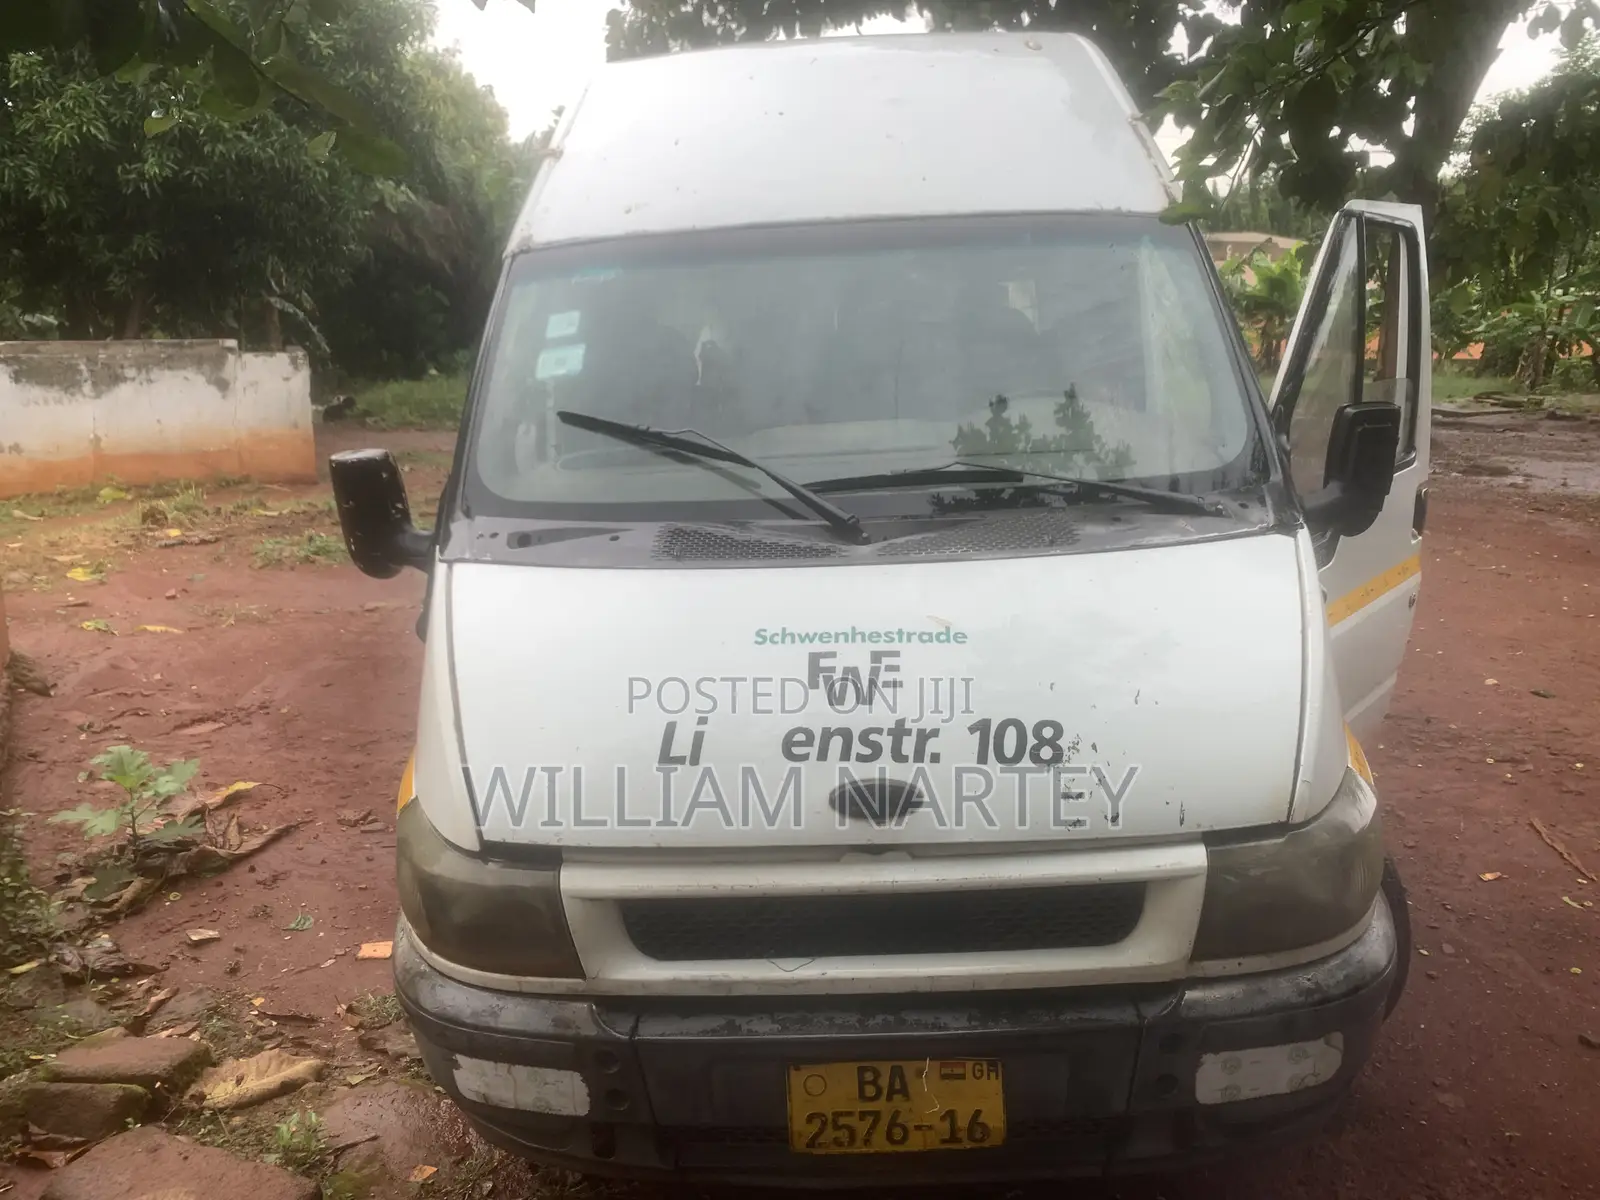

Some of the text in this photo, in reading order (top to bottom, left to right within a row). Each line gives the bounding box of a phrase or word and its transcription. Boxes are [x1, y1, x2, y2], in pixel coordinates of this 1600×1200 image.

[754, 626, 968, 645] Schwenhestrade
[967, 718, 1064, 766] 108
[857, 1065, 910, 1102] BA
[805, 1108, 991, 1149] 2576-16
